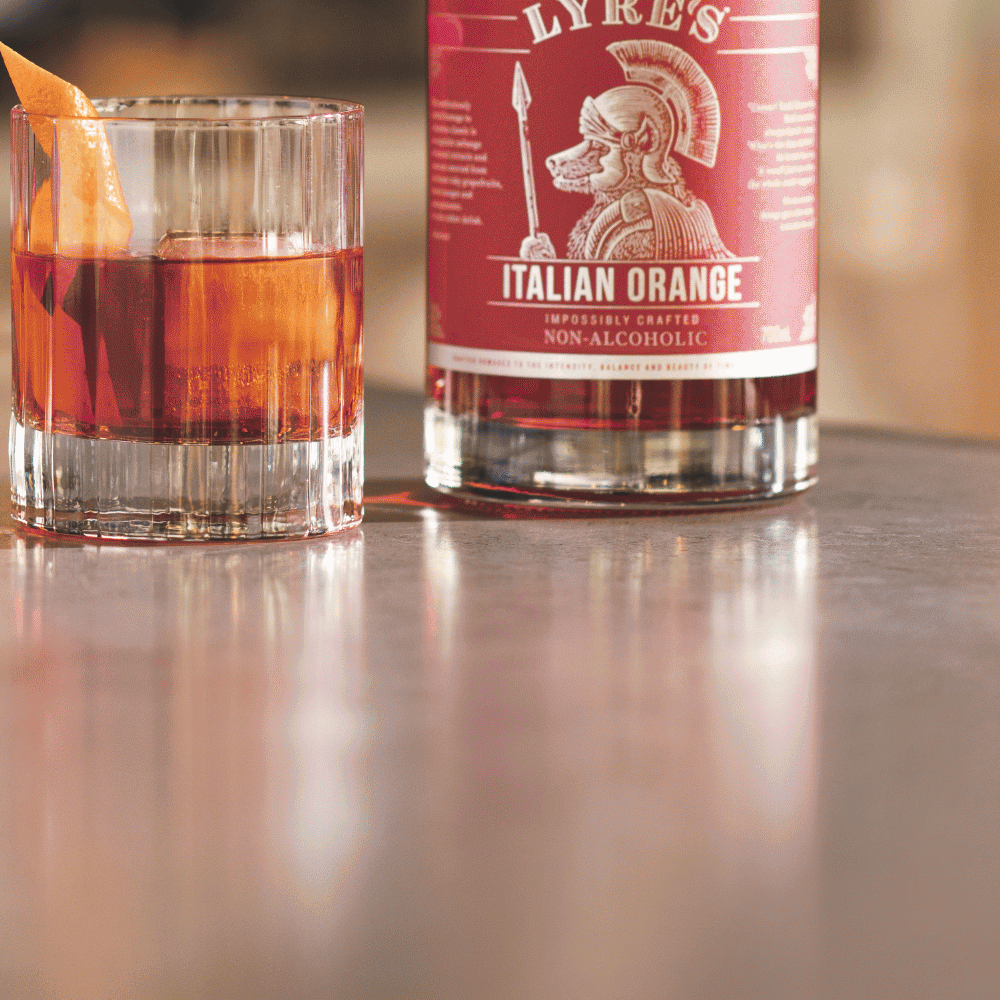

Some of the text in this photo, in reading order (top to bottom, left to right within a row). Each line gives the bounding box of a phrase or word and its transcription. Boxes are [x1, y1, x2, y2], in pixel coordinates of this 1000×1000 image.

[502, 263, 743, 303] ITALIAN ORANGE
[544, 313, 700, 326] IMPOSSIBLY CRAFTED
[544, 329, 708, 347] NON-ALCOHOLIC
